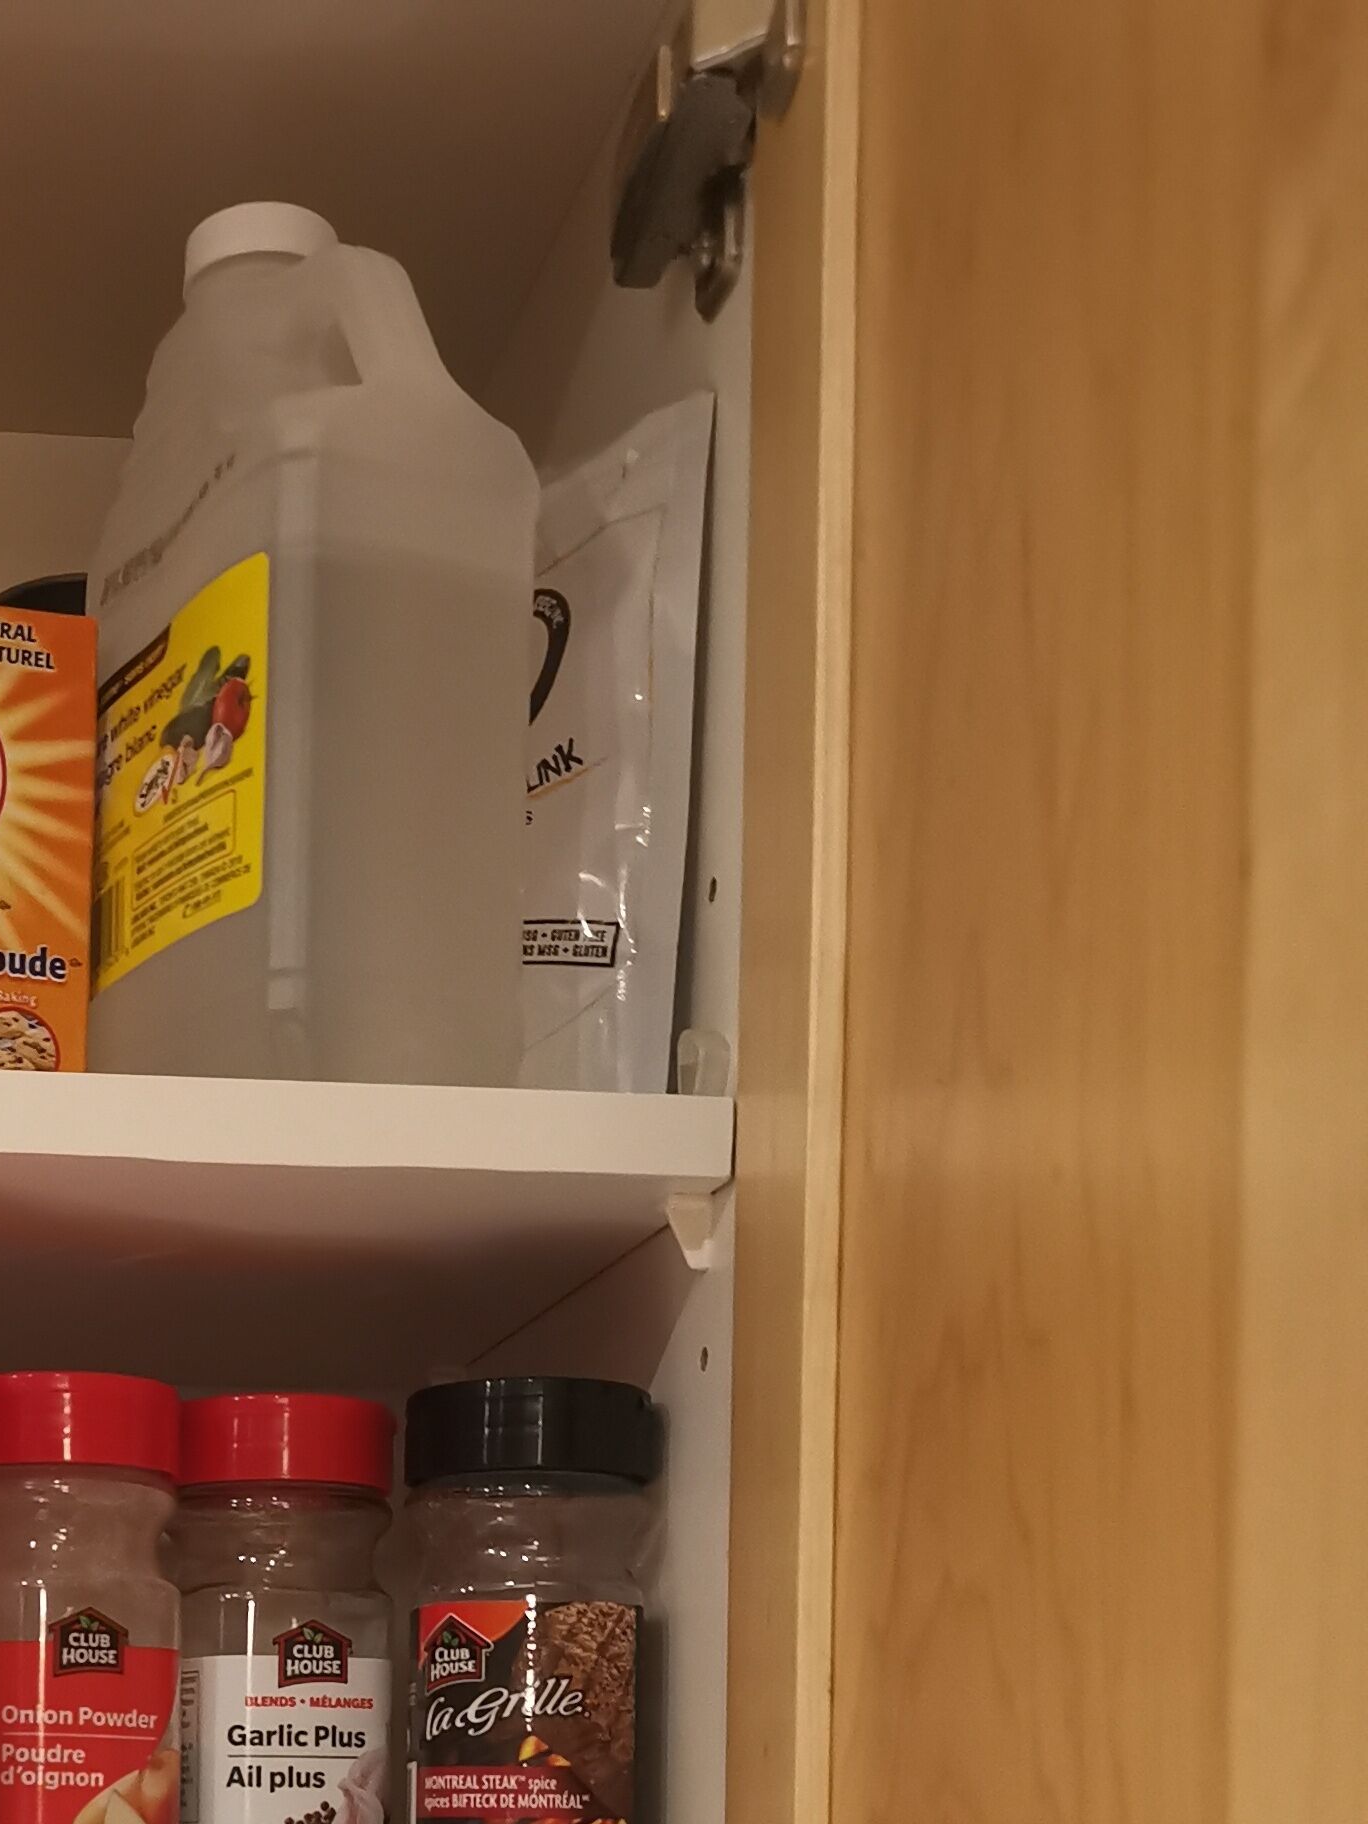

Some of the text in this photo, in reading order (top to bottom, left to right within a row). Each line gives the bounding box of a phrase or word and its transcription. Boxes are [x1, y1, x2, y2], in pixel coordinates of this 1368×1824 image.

[69, 1633, 110, 1648] CLUB
[62, 1648, 117, 1665] HOUSE
[293, 1644, 334, 1658] CLUB
[434, 1647, 470, 1662] CLUB
[286, 1659, 341, 1676] HOUSE
[431, 1660, 476, 1680] HOUSE
[245, 1694, 374, 1710] BLENDS MÉLANGES
[1, 1705, 158, 1729] Onion Powder
[227, 1724, 366, 1748] Garlic Plus
[1, 1744, 86, 1764] Poudre
[226, 1765, 326, 1793] Ail plus
[425, 1775, 479, 1790] MONTREAL
[528, 1776, 557, 1794] spice
[452, 1793, 497, 1808] BIFTECK
[500, 1794, 515, 1808] DE
